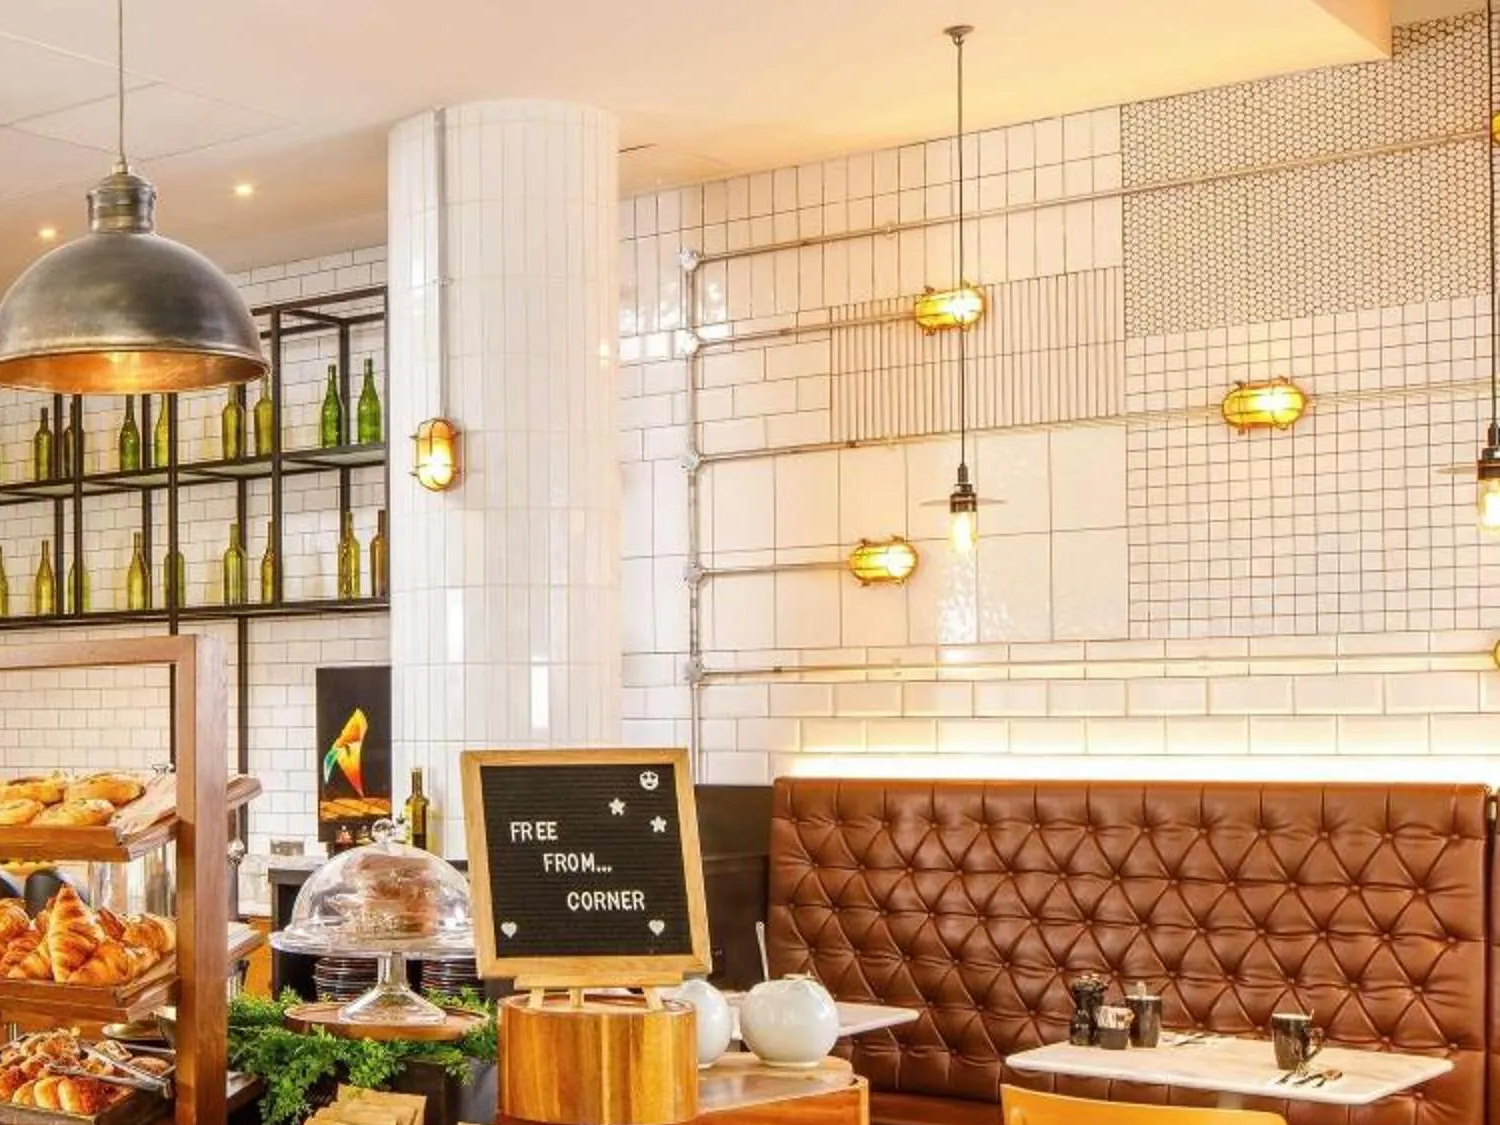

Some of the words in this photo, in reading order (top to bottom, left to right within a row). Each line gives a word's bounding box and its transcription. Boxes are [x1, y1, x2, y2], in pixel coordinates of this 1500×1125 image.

[510, 821, 559, 842] FREE
[543, 852, 613, 873] FROM...
[567, 889, 645, 911] CORNER
